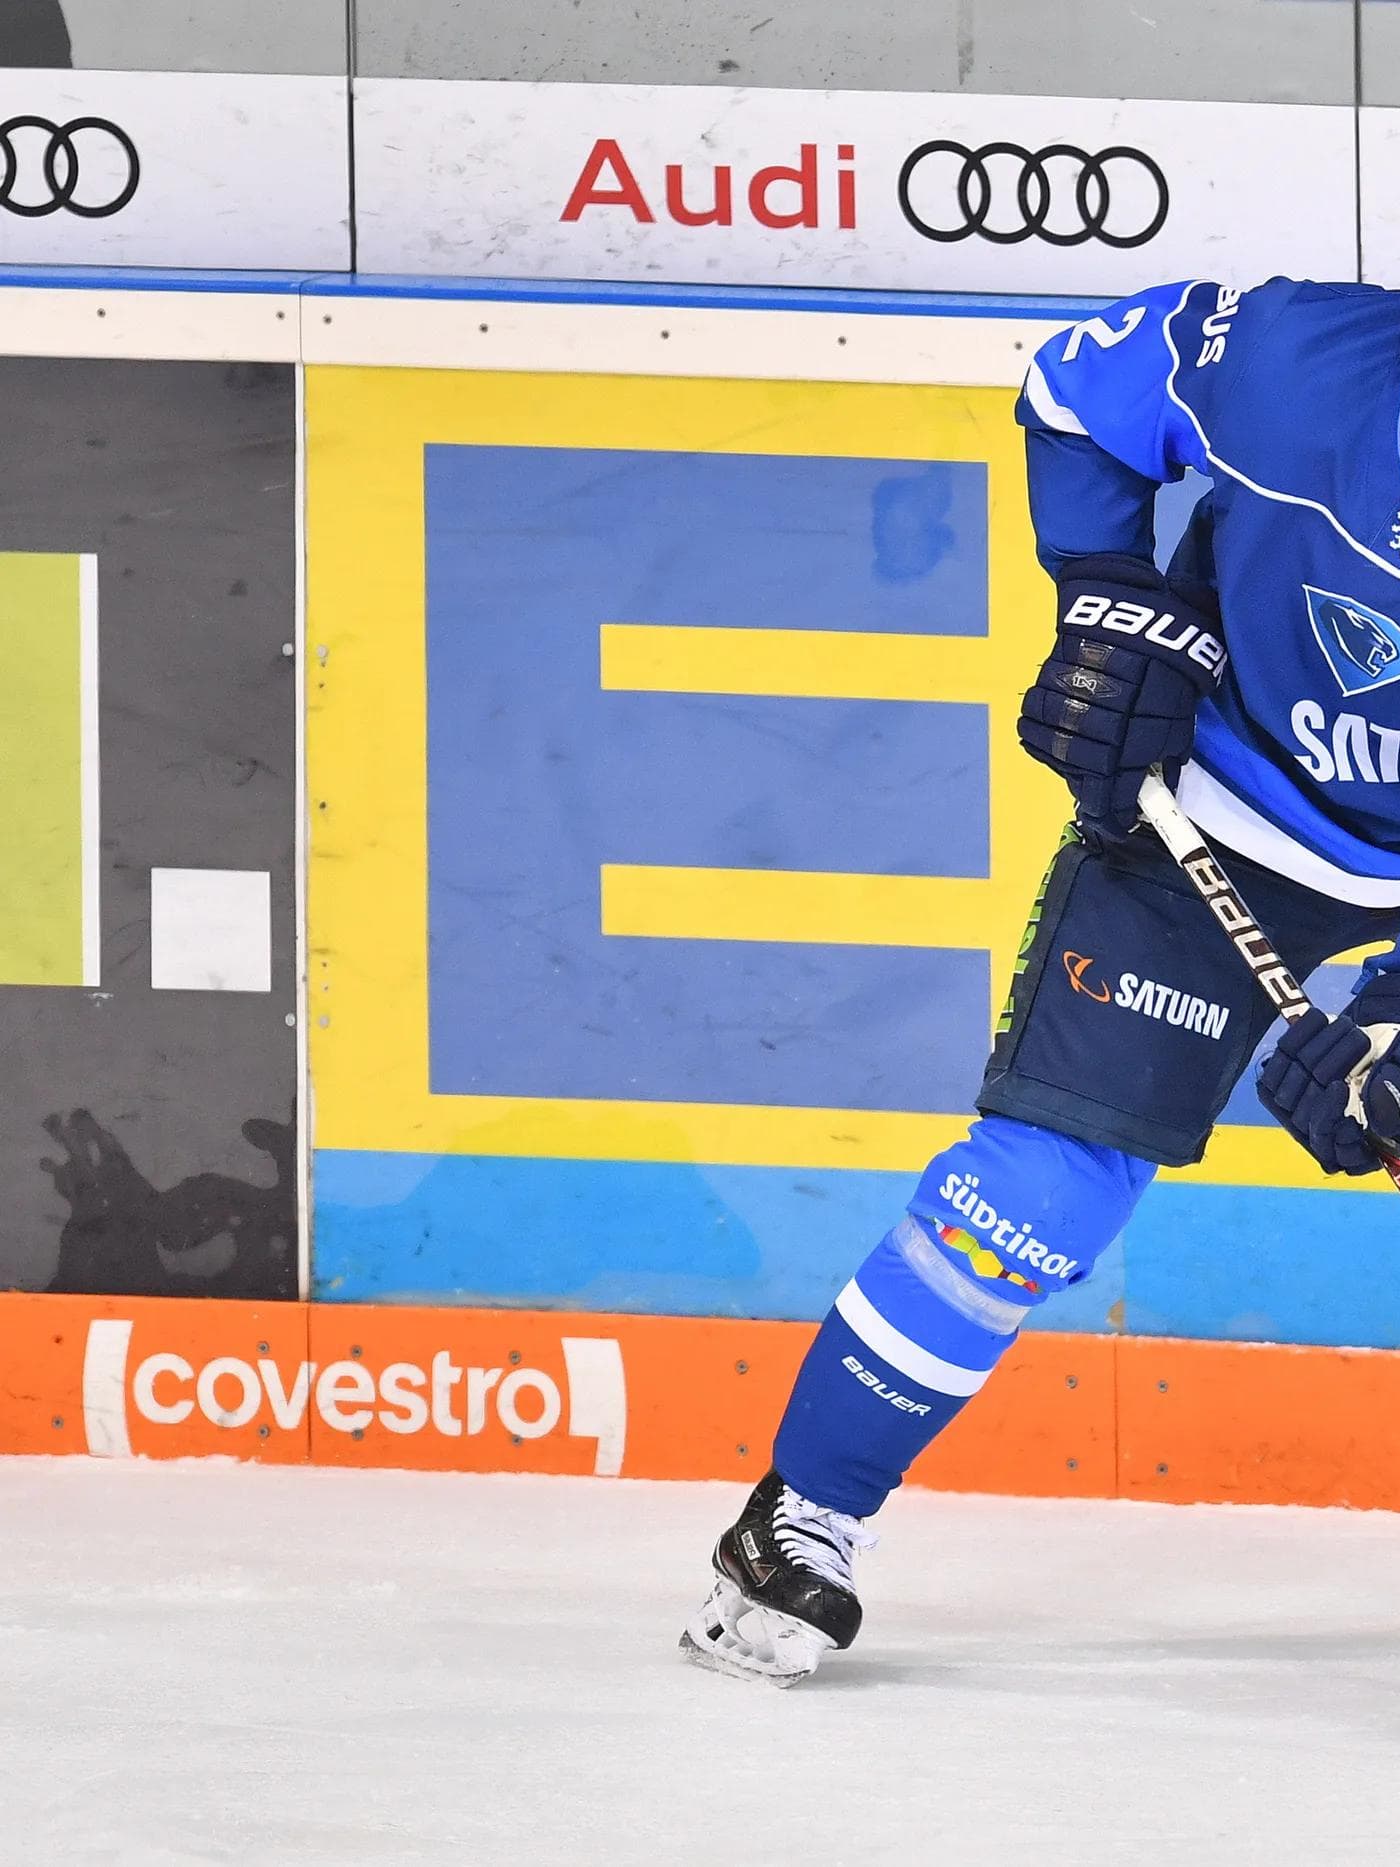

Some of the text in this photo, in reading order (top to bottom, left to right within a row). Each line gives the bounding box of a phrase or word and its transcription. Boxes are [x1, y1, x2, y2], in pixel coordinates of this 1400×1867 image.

[560, 138, 856, 230] Audi
[1060, 305, 1148, 363] 2
[1114, 972, 1231, 1041] SATURN
[132, 1350, 562, 1440] covestro
